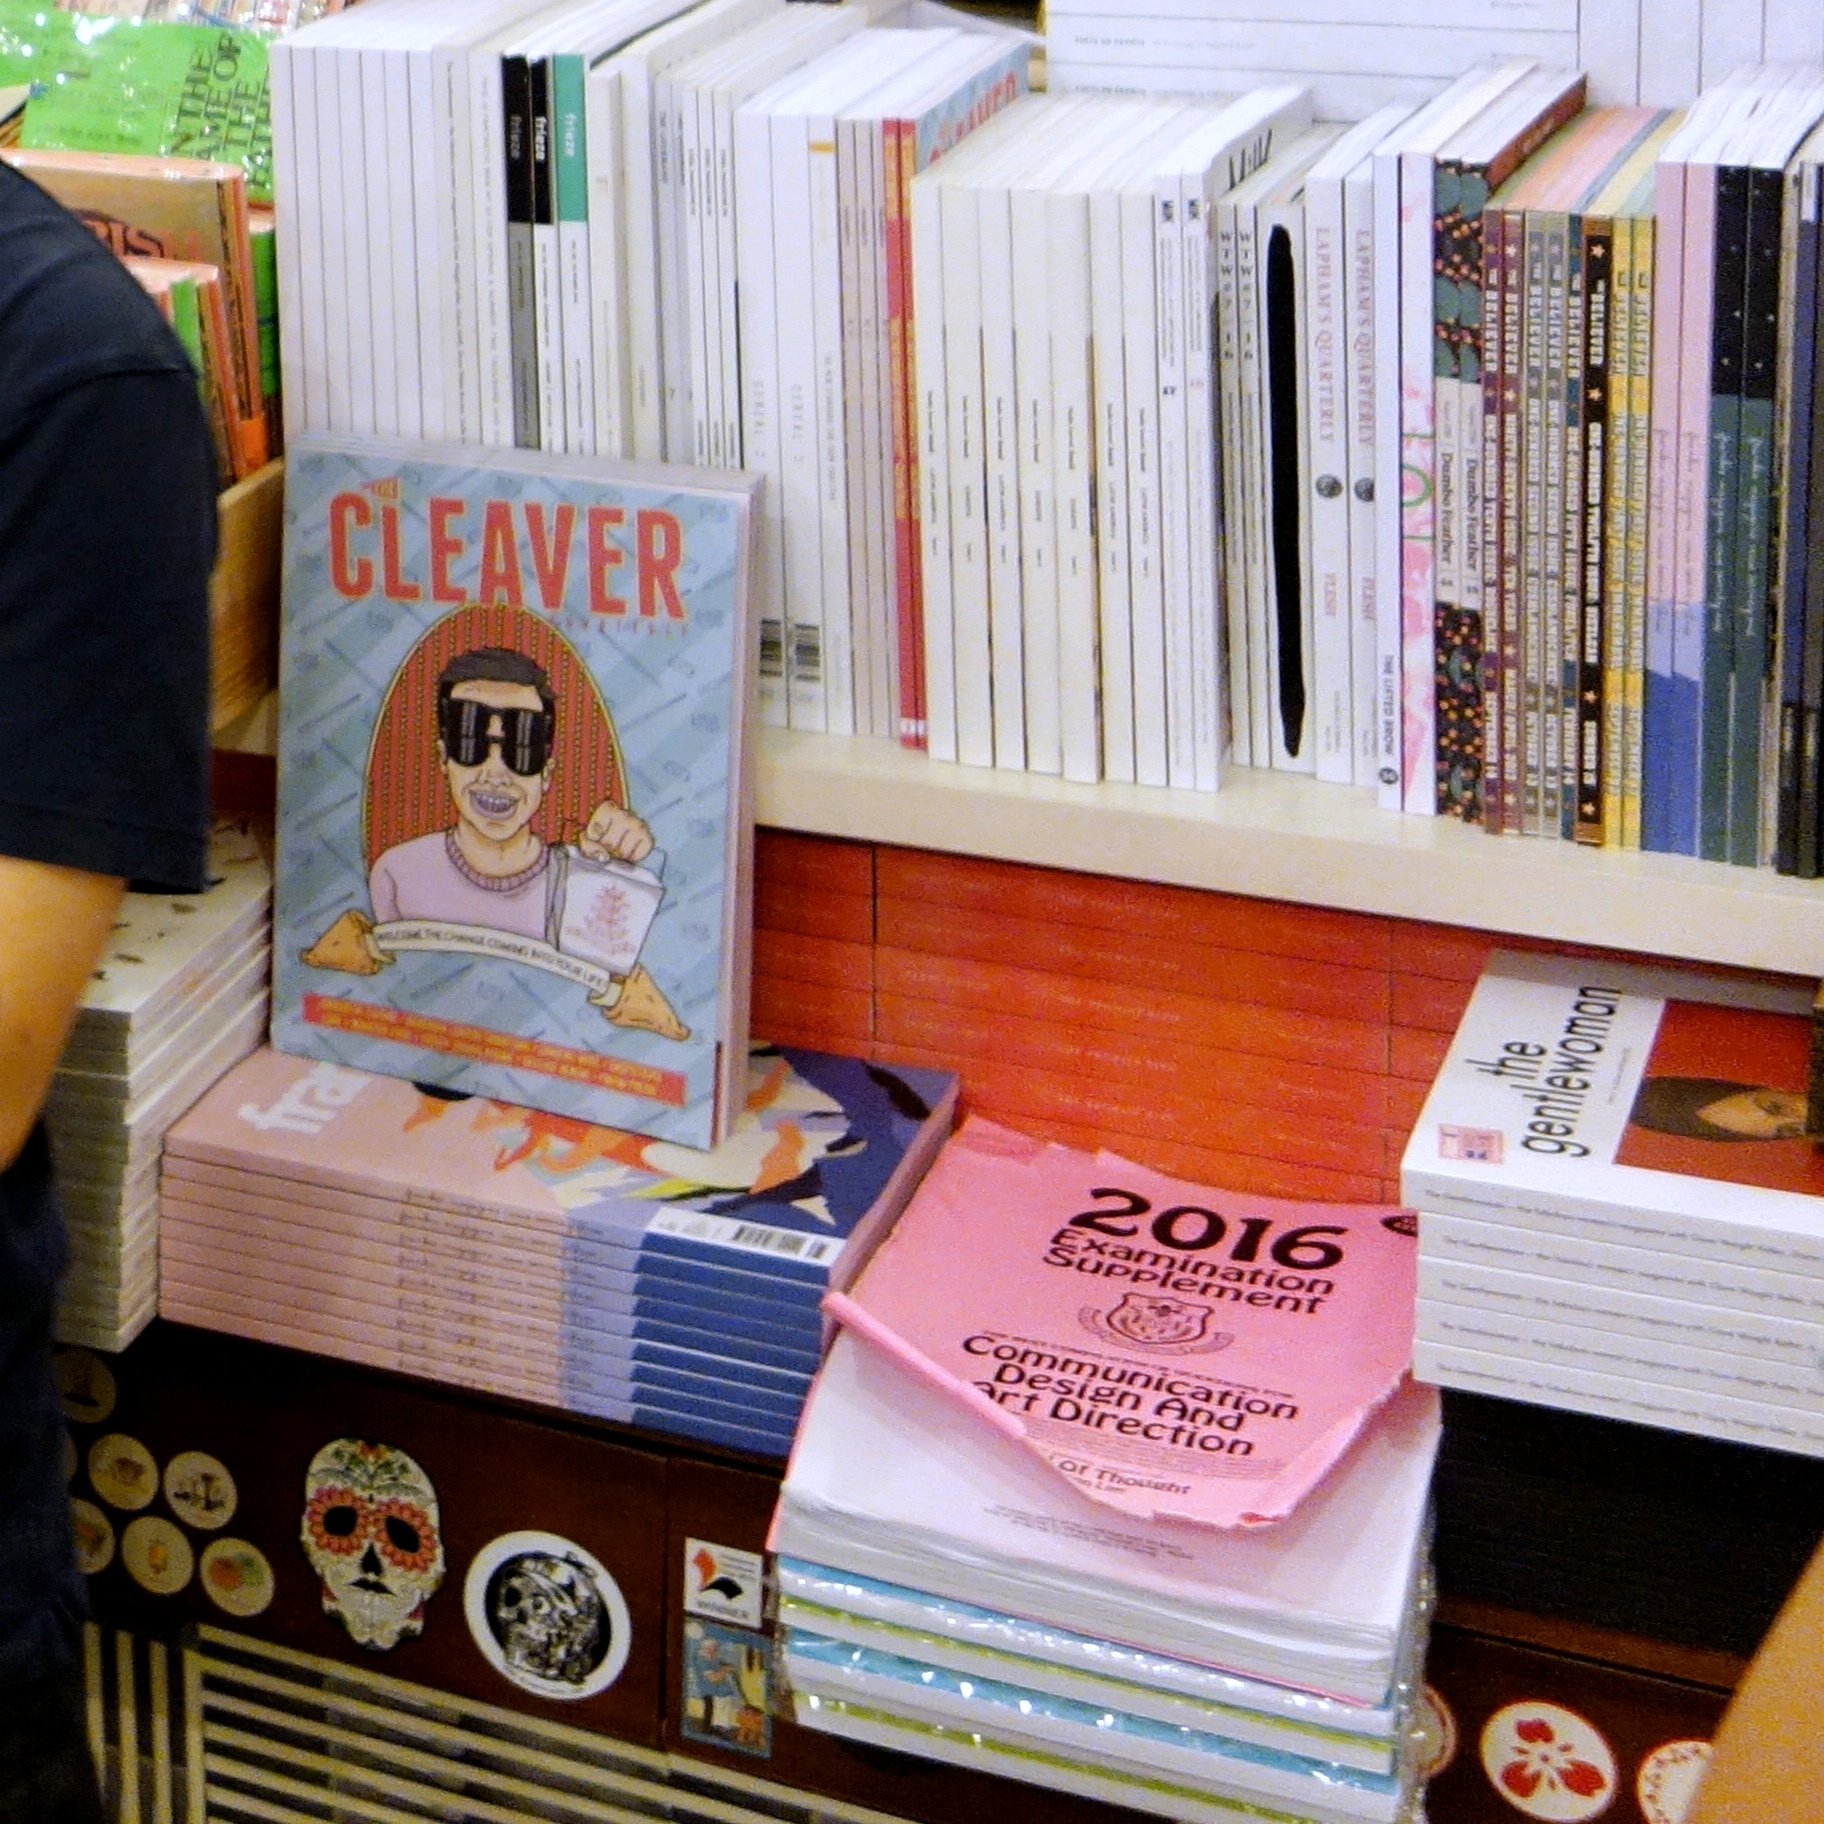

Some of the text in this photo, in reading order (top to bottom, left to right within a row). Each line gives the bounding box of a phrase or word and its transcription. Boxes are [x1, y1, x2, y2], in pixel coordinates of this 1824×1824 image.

[534, 116, 547, 161] frieze
[1484, 289, 1499, 372] BELIEVER
[1504, 292, 1519, 375] BELIEVER
[1528, 285, 1543, 368] BELIEVER
[1548, 287, 1563, 369] BELIEVER
[1567, 295, 1582, 378] BELIEVER
[1589, 293, 1605, 366] BELIEVER
[1612, 291, 1629, 376] BELIEVER
[1634, 292, 1650, 377] BELIEVER
[1440, 452, 1456, 564] Dumbo Feather
[1464, 457, 1481, 572] Dumbo Feather
[328, 491, 686, 620] CLEAVER
[1464, 1040, 1549, 1081] the
[1521, 984, 1623, 1158] gentlewoman
[1049, 1228, 1336, 1296] Examination
[1067, 1187, 1350, 1271] 2016
[1042, 1244, 1326, 1315] Supplement
[961, 1334, 1300, 1421] Communication
[993, 1362, 1143, 1412] Design
[1152, 1397, 1246, 1433] And
[1050, 1398, 1257, 1458] Direction
